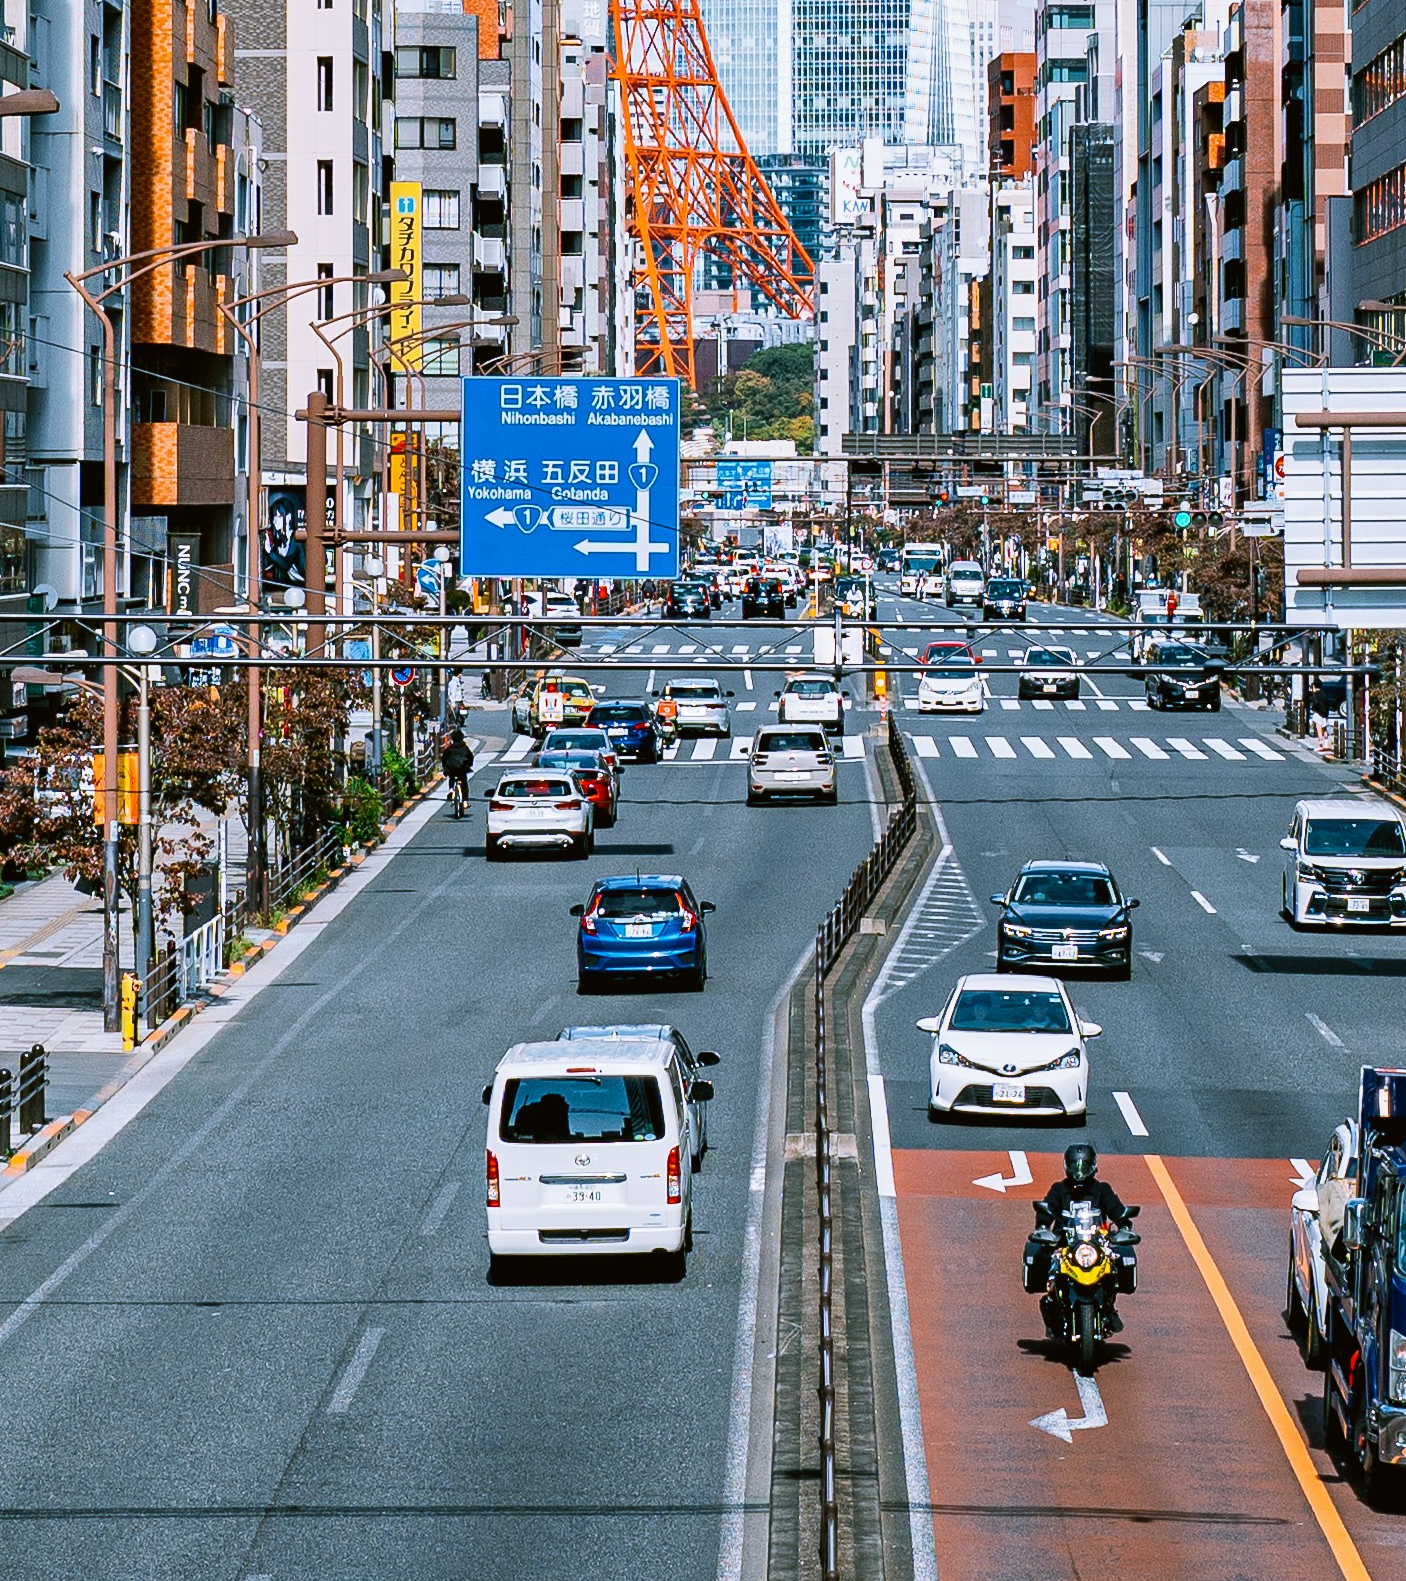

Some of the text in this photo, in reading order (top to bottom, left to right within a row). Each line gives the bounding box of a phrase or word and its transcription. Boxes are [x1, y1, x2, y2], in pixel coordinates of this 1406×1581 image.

[500, 384, 670, 410] 日本橋 赤羽橋
[501, 411, 674, 426] Nihonbashi Akabanebashi
[471, 458, 619, 484] 横浜 五反田
[638, 466, 646, 484] 1
[468, 486, 609, 501] Yokohama Gotanda
[523, 509, 531, 525] 1
[560, 511, 622, 526] 桜田通り
[178, 544, 191, 595] NUNC
